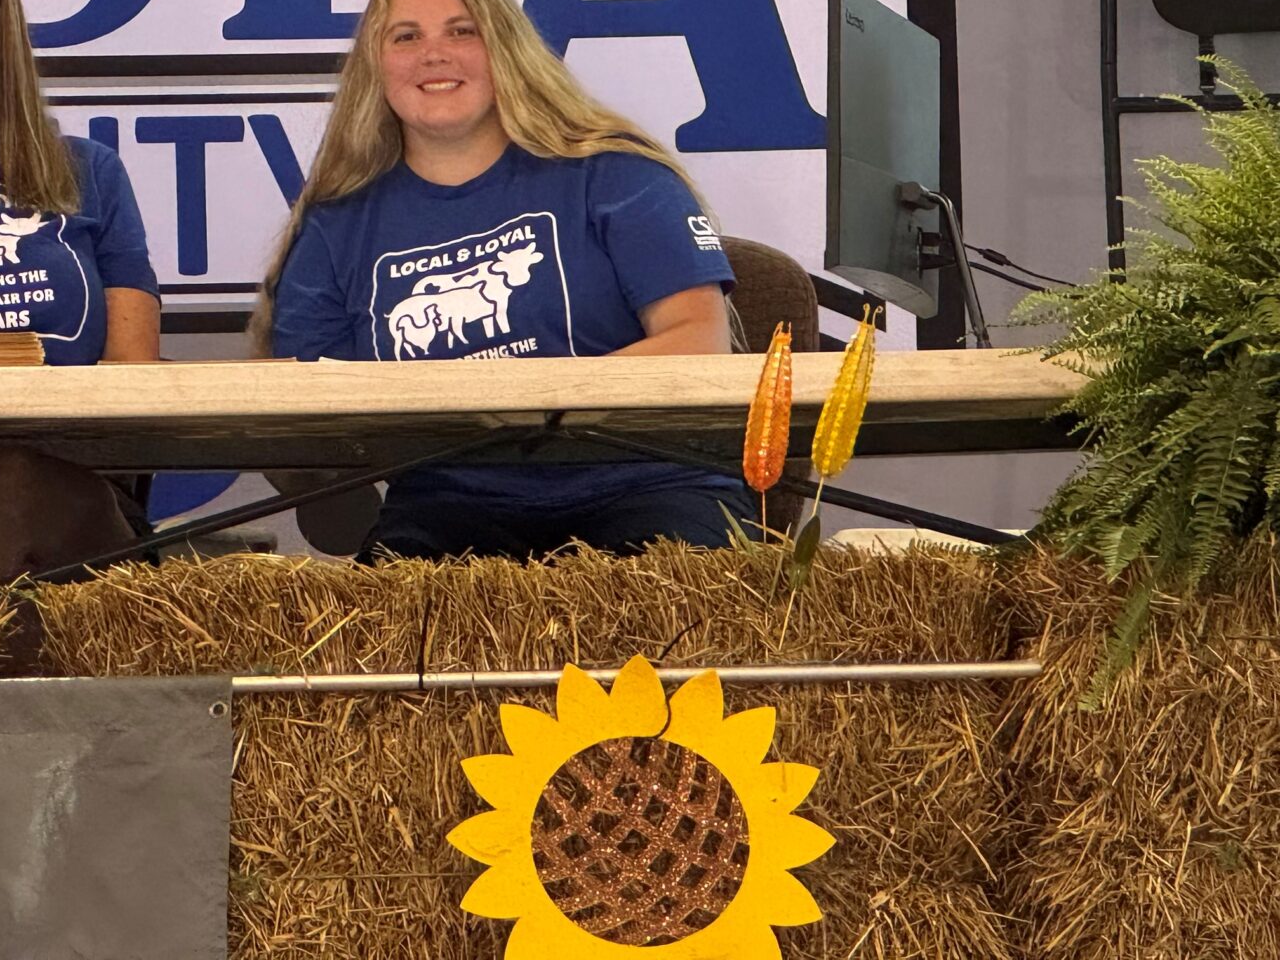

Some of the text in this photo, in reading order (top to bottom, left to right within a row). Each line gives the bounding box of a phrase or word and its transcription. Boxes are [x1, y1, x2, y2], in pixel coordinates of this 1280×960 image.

[390, 225, 536, 278] LOCAL & LOYAL
[18, 270, 49, 284] THE
[24, 289, 55, 303] FOR
[510, 338, 538, 355] THE
